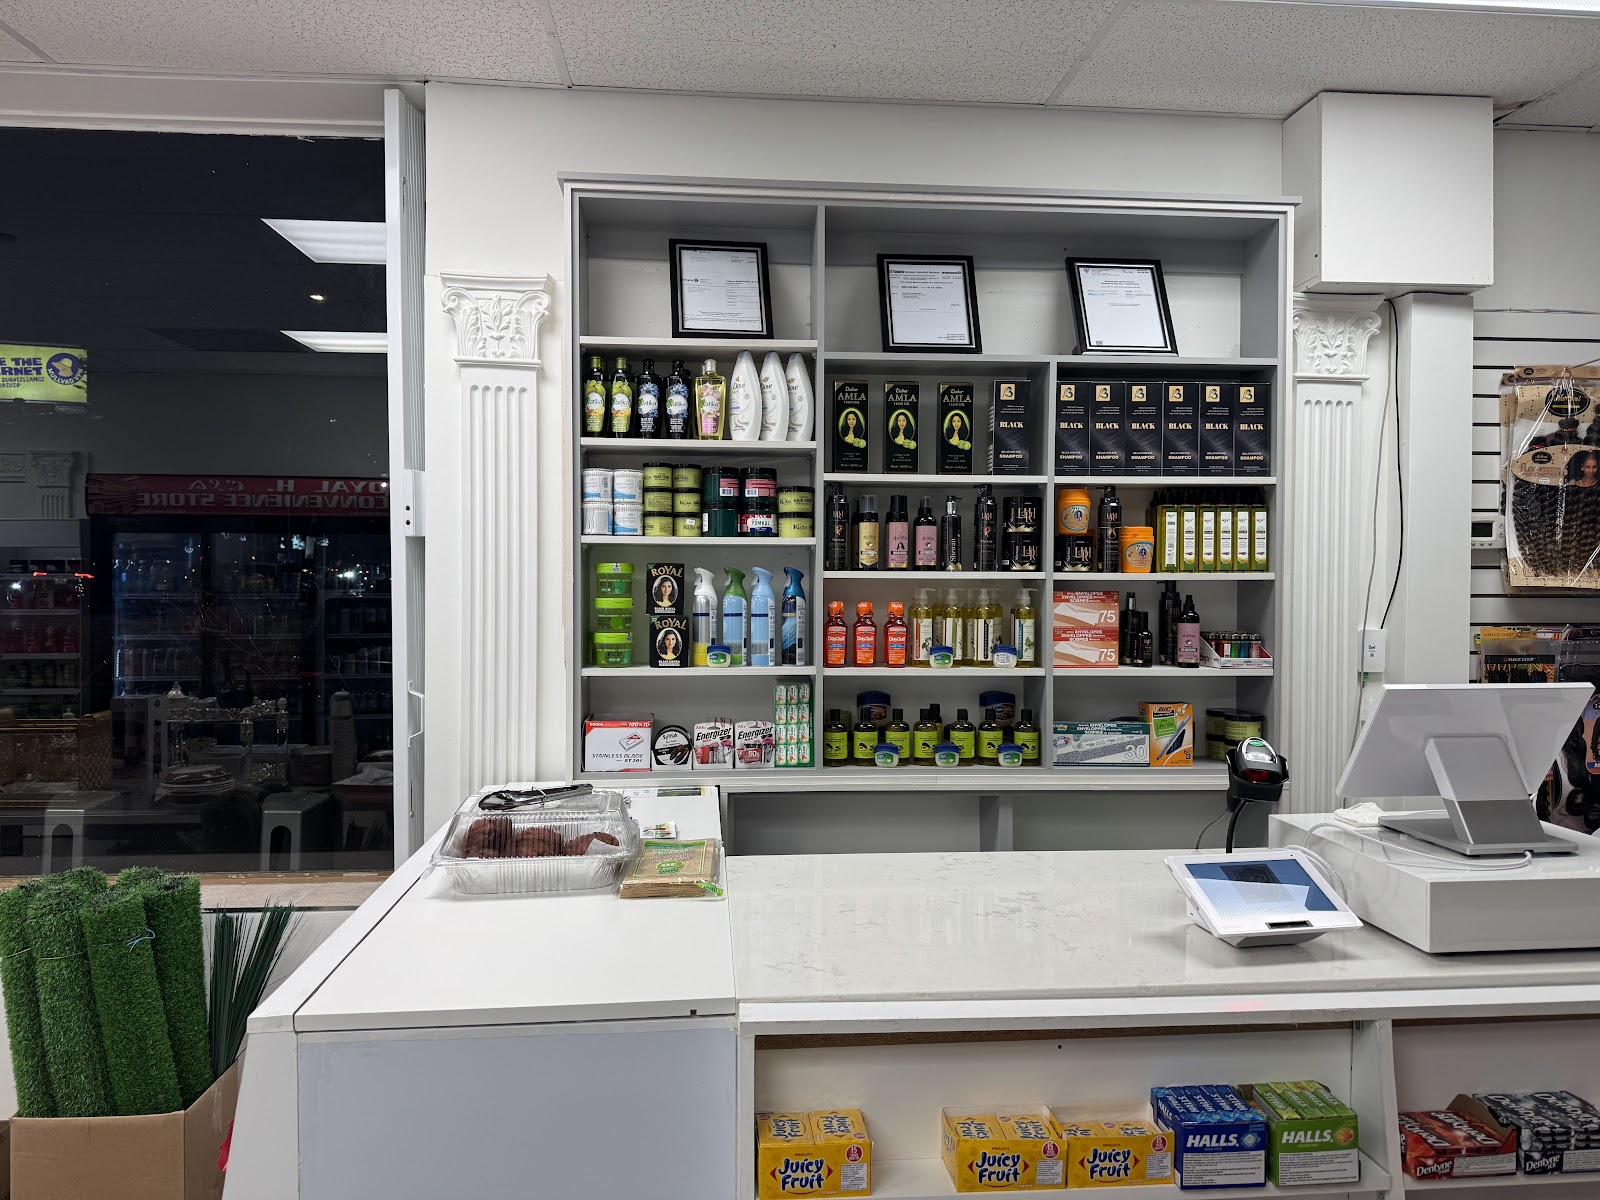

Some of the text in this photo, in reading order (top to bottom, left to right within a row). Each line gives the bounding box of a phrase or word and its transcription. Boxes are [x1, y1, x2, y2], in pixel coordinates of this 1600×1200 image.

[11, 357, 43, 366] THE
[47, 368, 84, 385] MULLVAD VPN
[732, 382, 746, 390] Dove
[838, 392, 866, 400] AMLA
[888, 394, 918, 402] AMLA
[942, 394, 972, 402] AMLA
[1096, 422, 1120, 430] BLACK
[650, 566, 683, 578] ROYAL
[655, 618, 687, 630] ROYAL
[1100, 610, 1116, 623] 75
[1099, 649, 1116, 661] 75
[696, 728, 732, 741] Energizer
[738, 727, 773, 739] Energizer
[1124, 744, 1147, 760] 30
[1158, 1099, 1173, 1121] HALLS
[1166, 1095, 1186, 1113] HALLS
[1178, 1095, 1200, 1113] HALLS
[1194, 1094, 1216, 1112] HALLS
[1211, 1093, 1233, 1111] HALLS
[1225, 1094, 1249, 1111] HALLS
[1487, 1095, 1560, 1128] Dentyne
[772, 1119, 788, 1139] Juicy
[786, 1118, 803, 1138] Fruit
[820, 1116, 838, 1134] Fruit
[834, 1114, 851, 1134] Juicy
[957, 1122, 974, 1138] Frui
[1430, 1112, 1501, 1144] Dentyne
[976, 1152, 1021, 1168] Juicy
[1087, 1148, 1131, 1164] Juicy
[1526, 1154, 1560, 1172] Dentyne
[778, 1158, 824, 1174] Juicy
[1090, 1163, 1131, 1180] Fruit
[1417, 1160, 1452, 1176] Dentyne
[782, 1174, 824, 1191] Fruit
[978, 1168, 1020, 1184] Fruit
